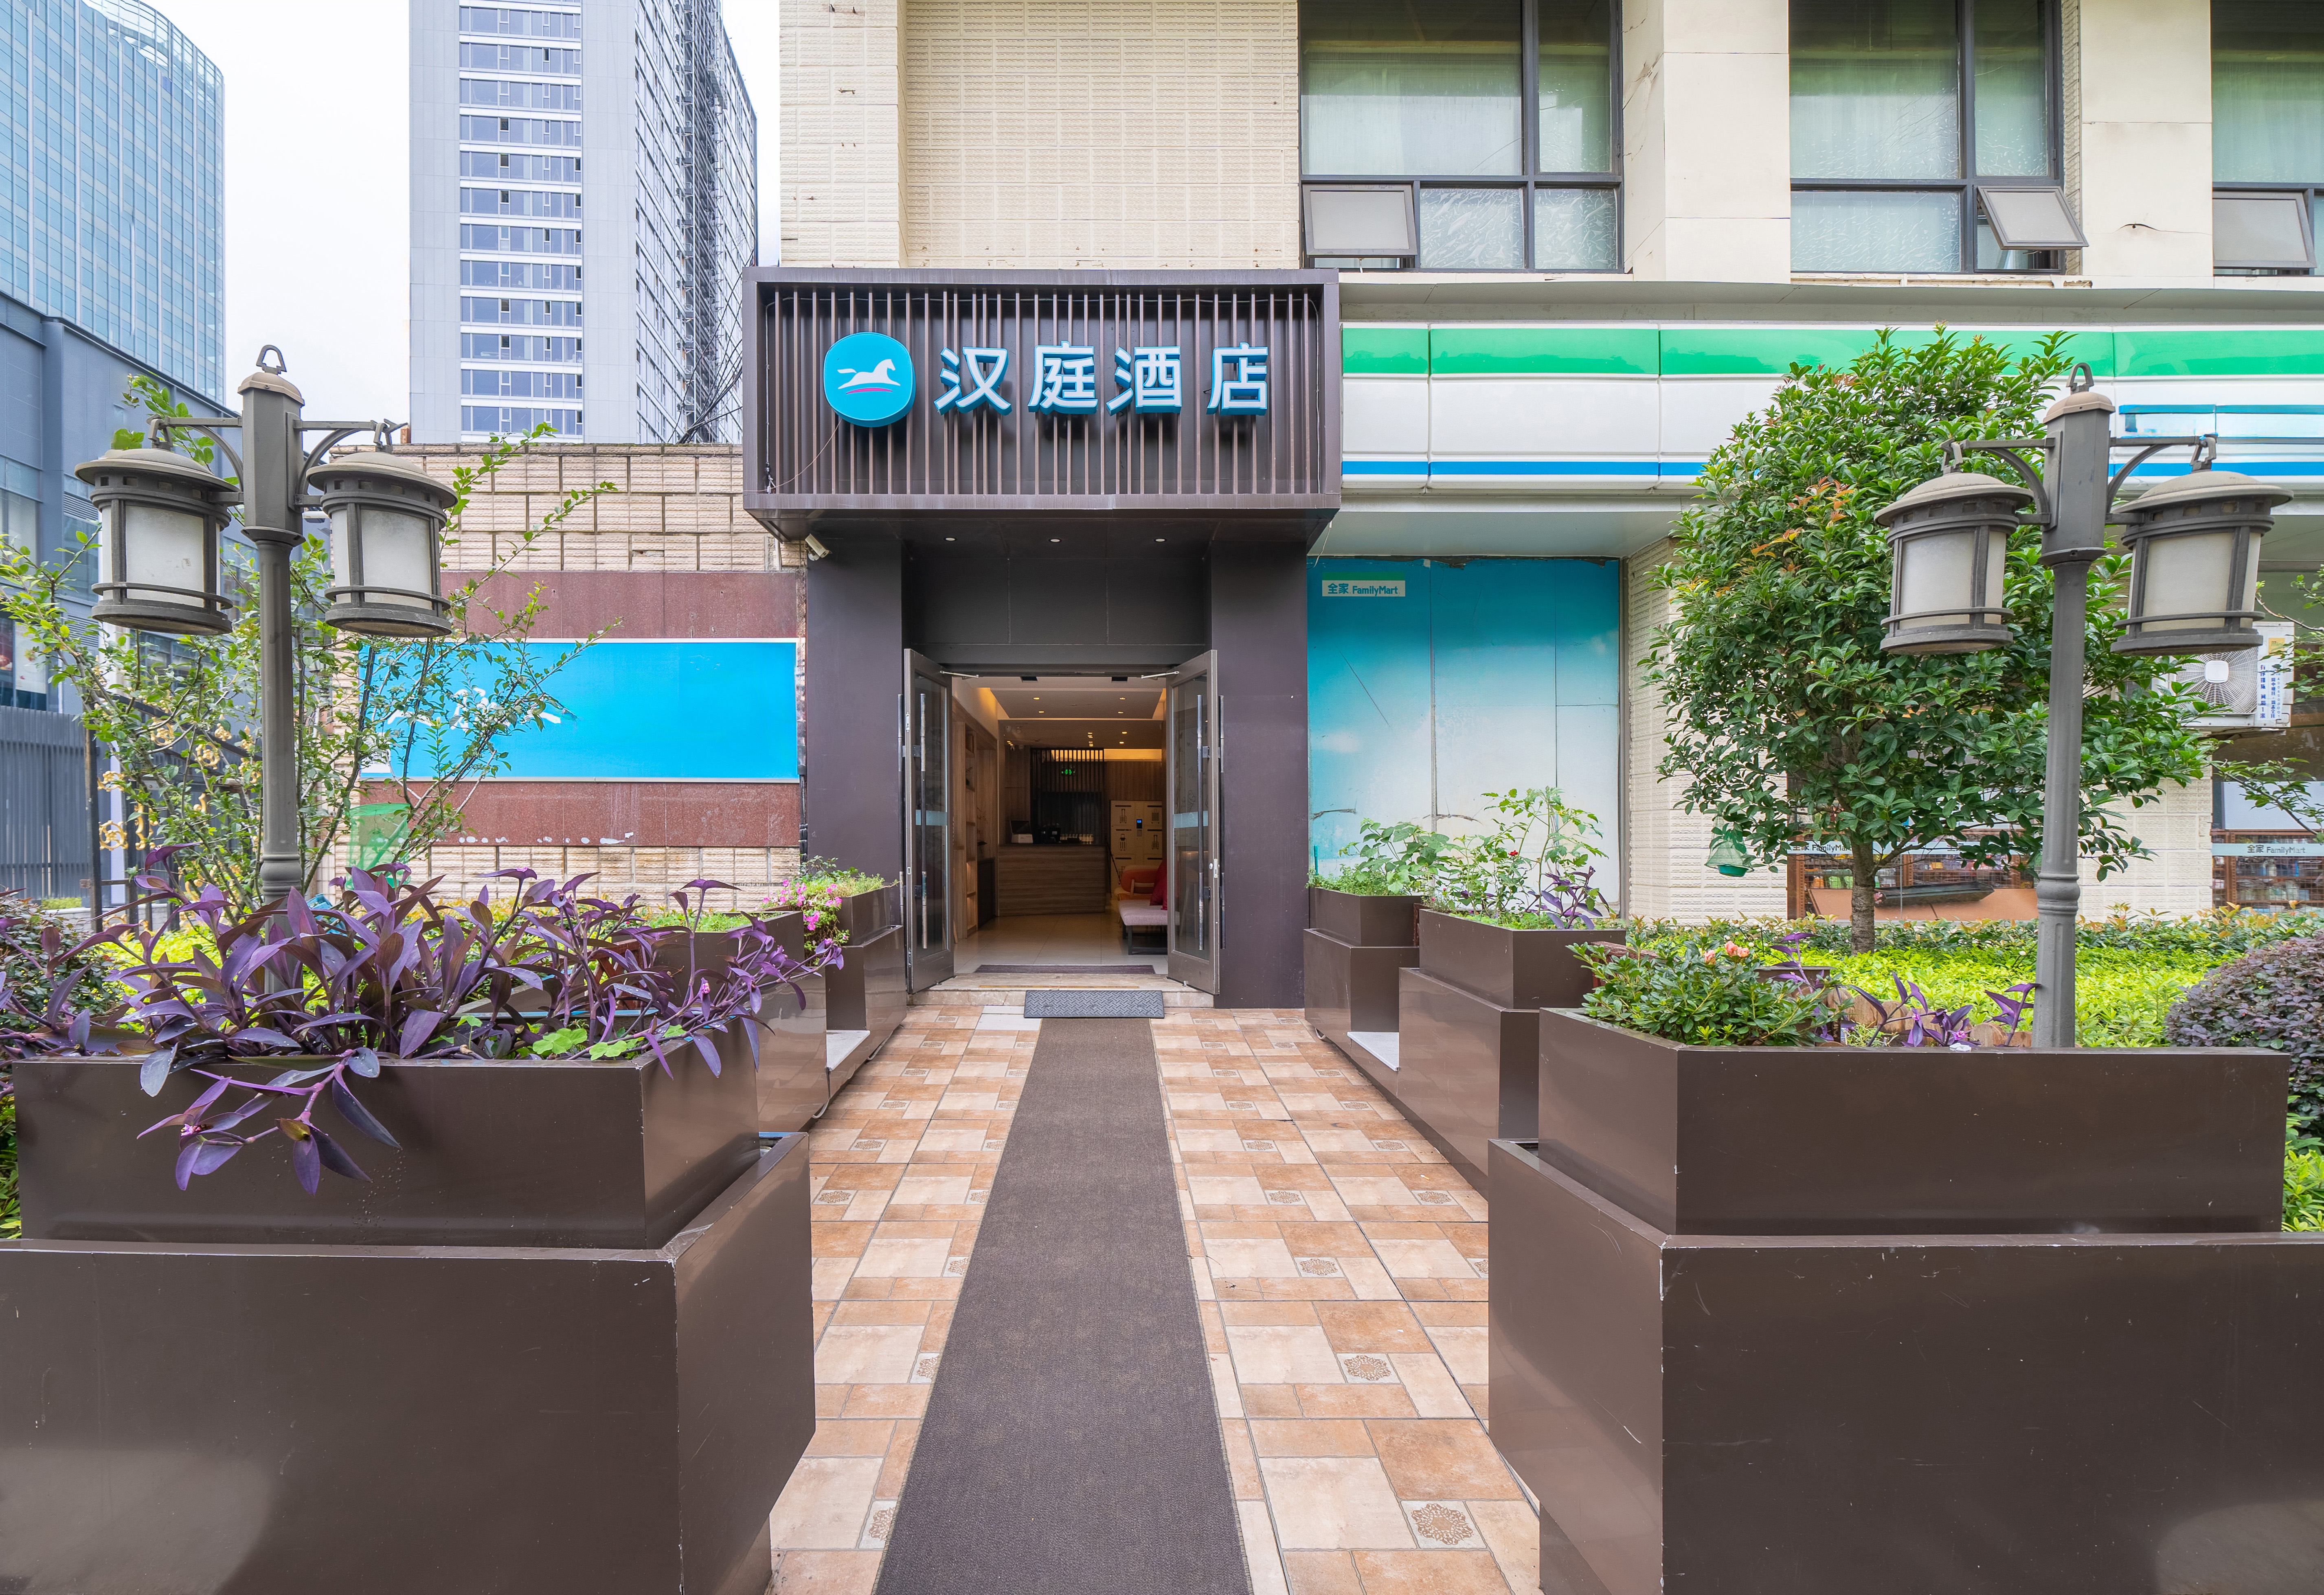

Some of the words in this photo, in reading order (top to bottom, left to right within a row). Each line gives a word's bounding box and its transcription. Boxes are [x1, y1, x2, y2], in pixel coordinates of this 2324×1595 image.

[934, 340, 1269, 416] 汉庭酒店
[1328, 583, 1349, 594] 全家
[1352, 585, 1398, 596] FamilyMart
[2247, 845, 2264, 853] 全家
[2266, 846, 2306, 855] FamilyMart
